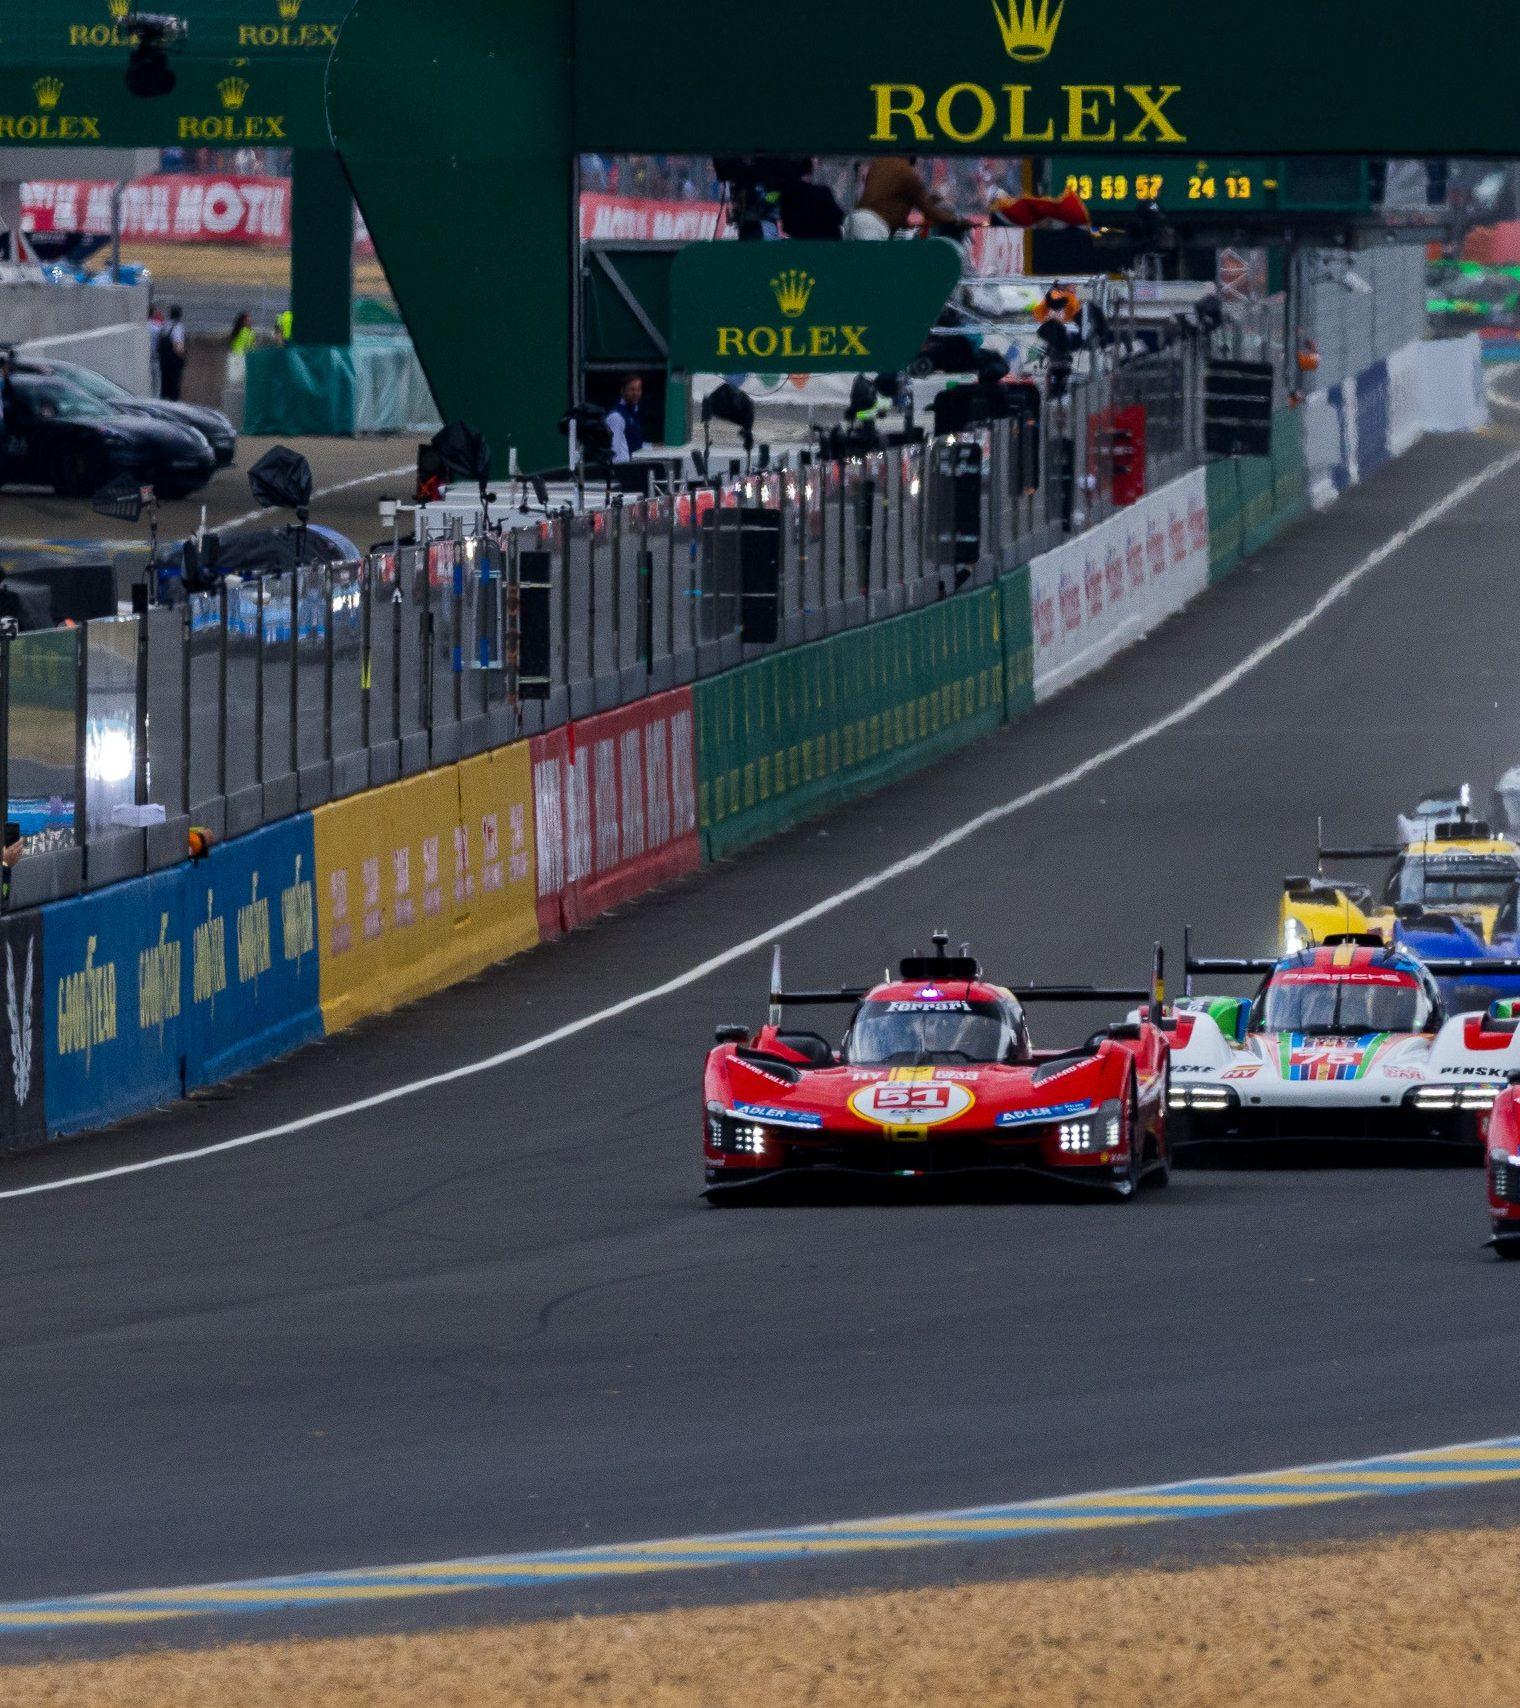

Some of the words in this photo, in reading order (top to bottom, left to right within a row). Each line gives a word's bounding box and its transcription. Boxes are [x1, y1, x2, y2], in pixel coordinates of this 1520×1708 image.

[69, 23, 141, 47] ROL
[238, 24, 340, 46] ROLEX
[869, 82, 1187, 143] ROLEX
[0, 115, 101, 139] ROLEX
[177, 115, 287, 139] ROLEX
[1135, 174, 1163, 200] 57
[1188, 176, 1217, 199] 24
[1225, 176, 1251, 199] 13
[174, 181, 286, 237] MOTU
[716, 326, 871, 357] ROLEX
[1283, 973, 1400, 983] PORSCHE
[885, 1001, 972, 1012] Ferrari
[1298, 1052, 1356, 1065] 75
[877, 1088, 945, 1107] 51
[739, 1105, 787, 1118] ADLER
[1003, 1107, 1052, 1121] ADLER
